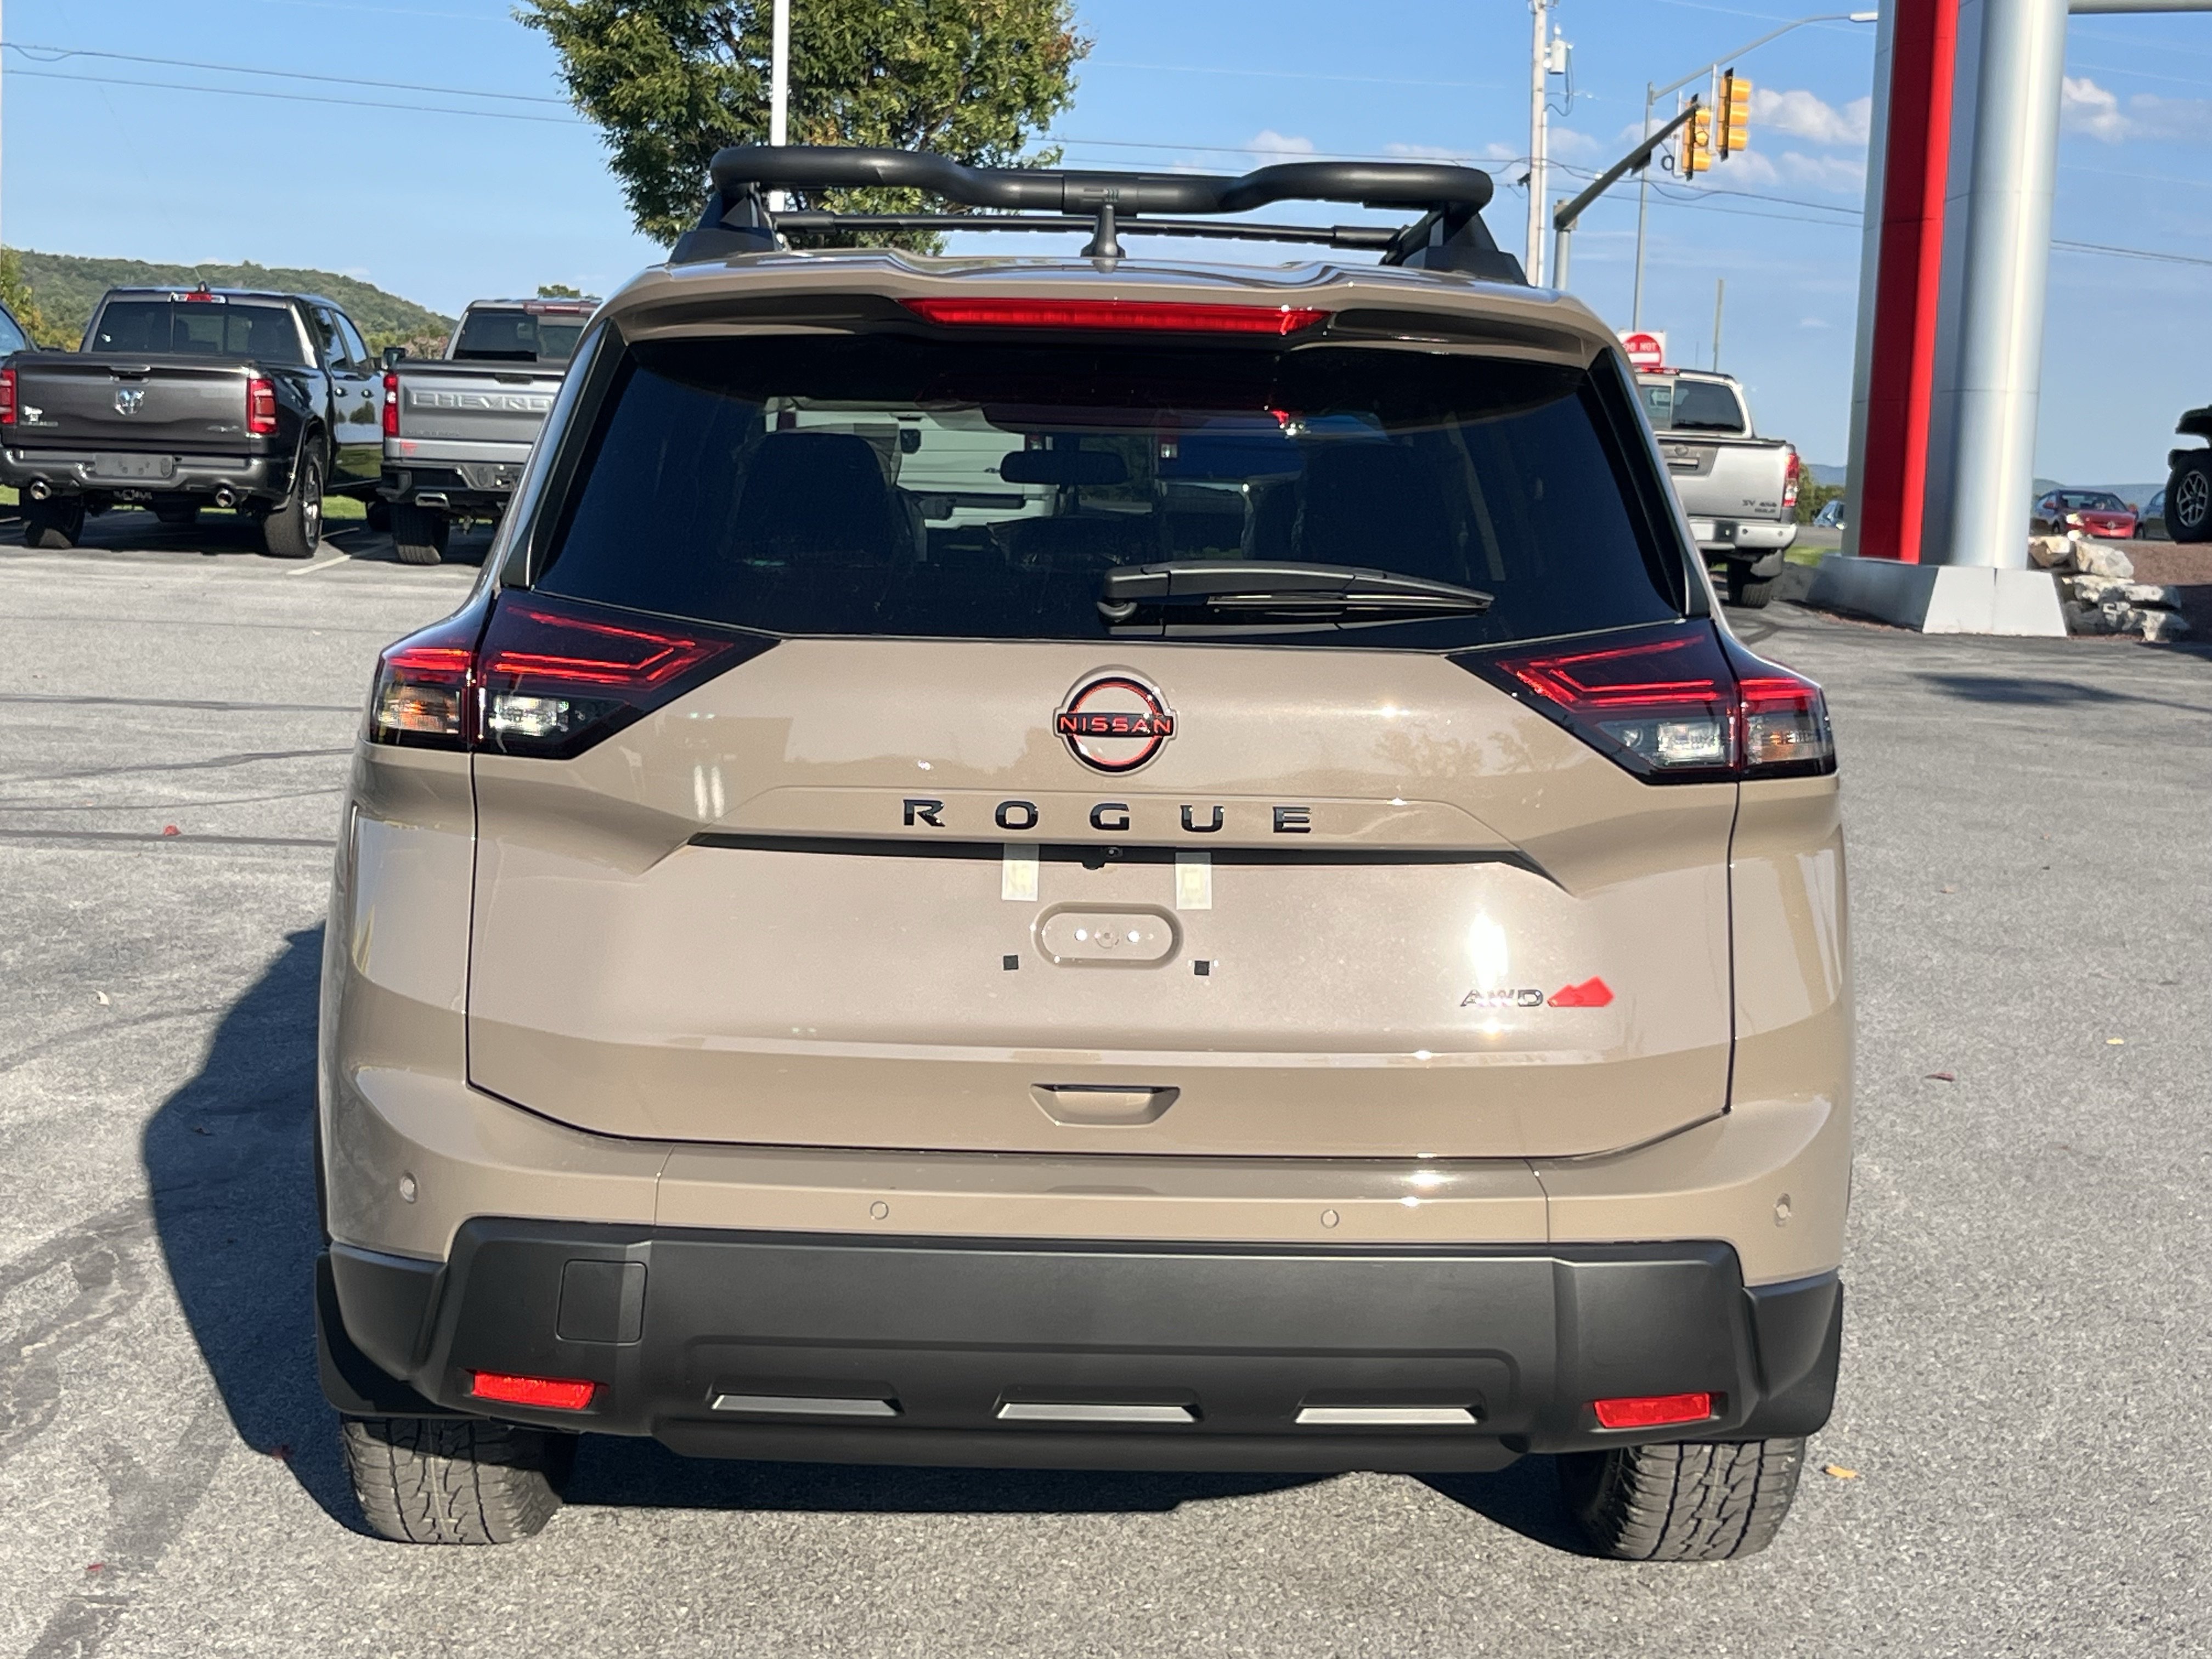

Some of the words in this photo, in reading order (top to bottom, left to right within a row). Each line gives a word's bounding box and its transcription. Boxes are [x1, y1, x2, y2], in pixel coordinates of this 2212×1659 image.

[1640, 342, 1657, 351] NOT
[1059, 716, 1171, 734] NISSAN
[903, 799, 1311, 833] ROGUE
[1460, 989, 1544, 1007] AWD
